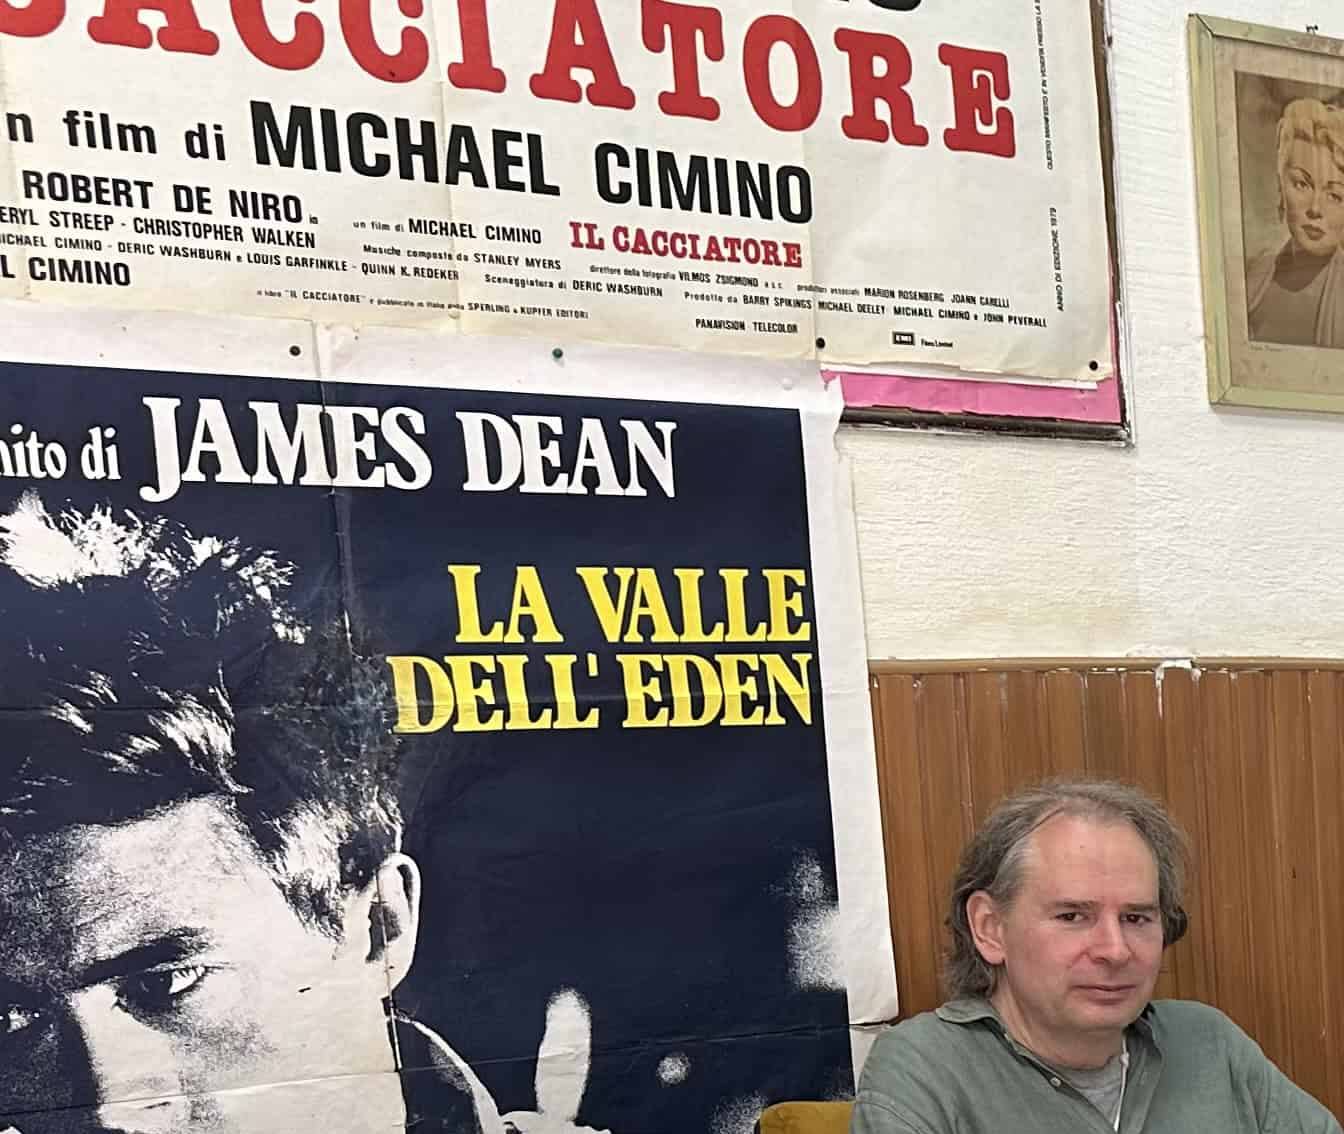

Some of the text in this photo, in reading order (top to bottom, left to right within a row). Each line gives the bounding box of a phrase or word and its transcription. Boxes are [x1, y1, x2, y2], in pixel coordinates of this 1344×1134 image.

[0, 0, 1017, 159] CCIATORE
[62, 110, 157, 154] film
[185, 122, 226, 160] di
[250, 100, 560, 196] MICHAEL
[595, 142, 812, 224] CIMINO
[22, 169, 154, 209] ROBERT
[173, 184, 213, 215] DE
[229, 189, 303, 224] NIRO
[49, 210, 114, 231] STREEP
[133, 217, 244, 242] CHRISTOPHER
[252, 227, 316, 249] WALKEN
[371, 220, 390, 231] film
[409, 218, 477, 239] MICHAEL
[485, 225, 542, 244] CIMINO
[569, 221, 802, 268] IL CACCIATORE
[28, 256, 131, 286] CIMINO
[54, 237, 102, 251] CIMINO
[118, 241, 155, 255] DERIC
[160, 245, 231, 262] WASHBURN
[247, 253, 281, 266] LOUIS
[286, 257, 348, 272] GARFINKLE
[361, 262, 396, 276] QUINN
[413, 268, 460, 281] REDEKER
[474, 252, 519, 267] STANLEY
[525, 257, 561, 271] MYERS
[678, 271, 711, 283] VILMOS
[484, 273, 554, 290] Sceneggiatura
[572, 279, 603, 292] DERIC
[606, 283, 663, 297] WASHBURN
[864, 287, 895, 299] MARION
[950, 292, 976, 305] JOANN
[695, 318, 798, 333] PANAVISION TELECOLOR
[743, 295, 769, 306] BARRY
[774, 297, 812, 310] SPIKINGS
[818, 301, 853, 313] MICHAEL
[857, 303, 885, 315] DEELEY
[893, 306, 934, 318] MICHAEL
[938, 308, 970, 321] CIMINO
[81, 426, 121, 480] di
[139, 397, 432, 502] JAMES
[456, 411, 677, 498] DEAN
[448, 565, 812, 644] LA VALLE
[386, 653, 813, 734] DELL' EDEN
